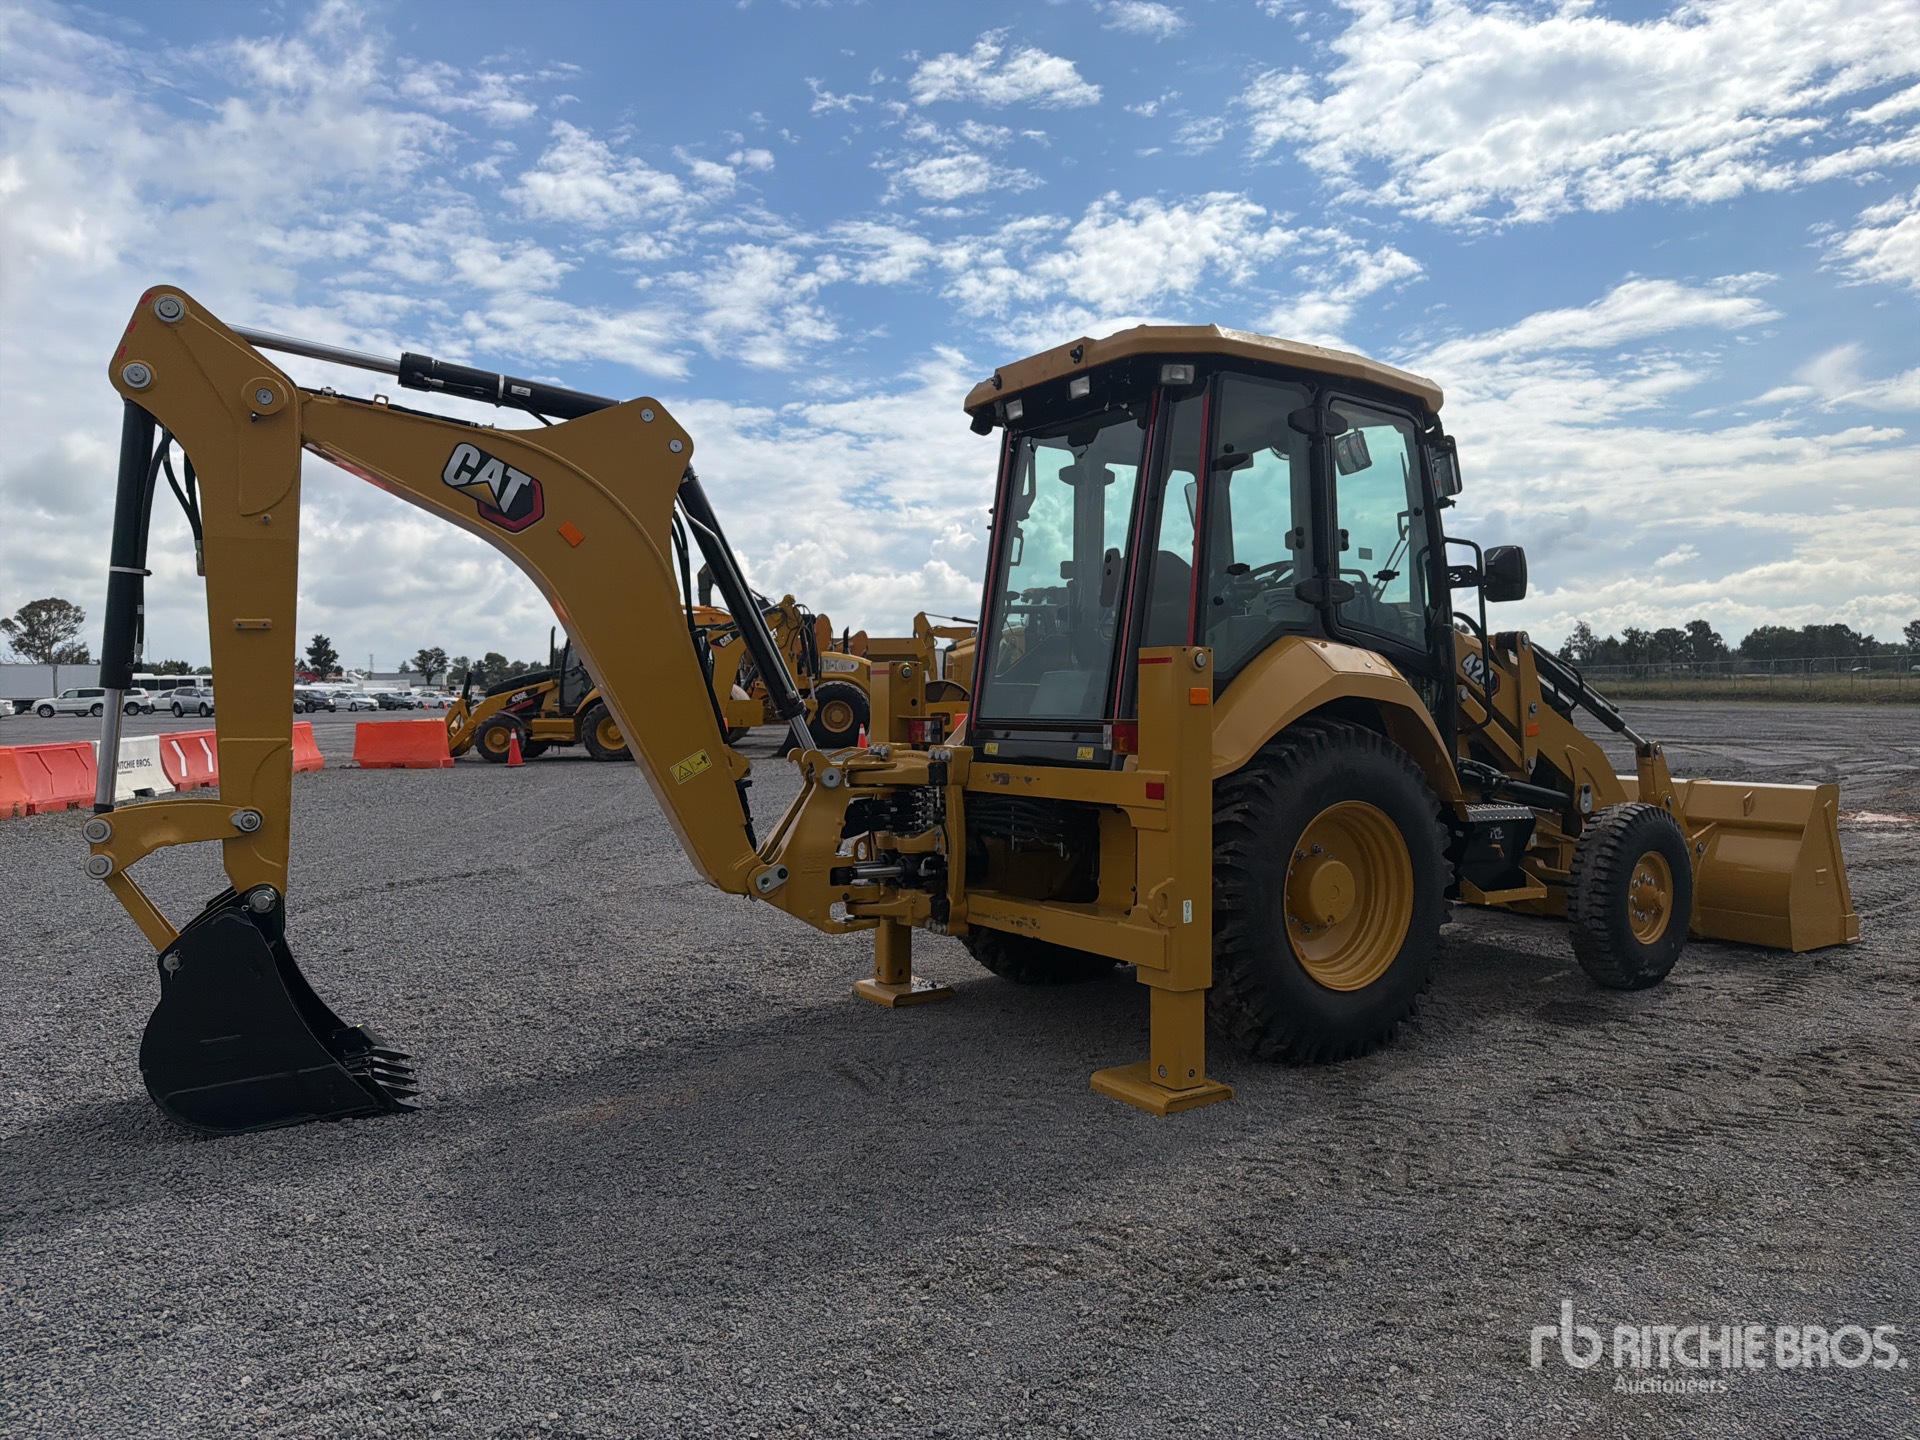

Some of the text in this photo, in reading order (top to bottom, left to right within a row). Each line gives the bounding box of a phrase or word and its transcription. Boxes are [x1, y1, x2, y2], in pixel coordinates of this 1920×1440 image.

[443, 443, 532, 514] CAT
[719, 632, 734, 647] CAT
[117, 760, 135, 769] ITCHIE
